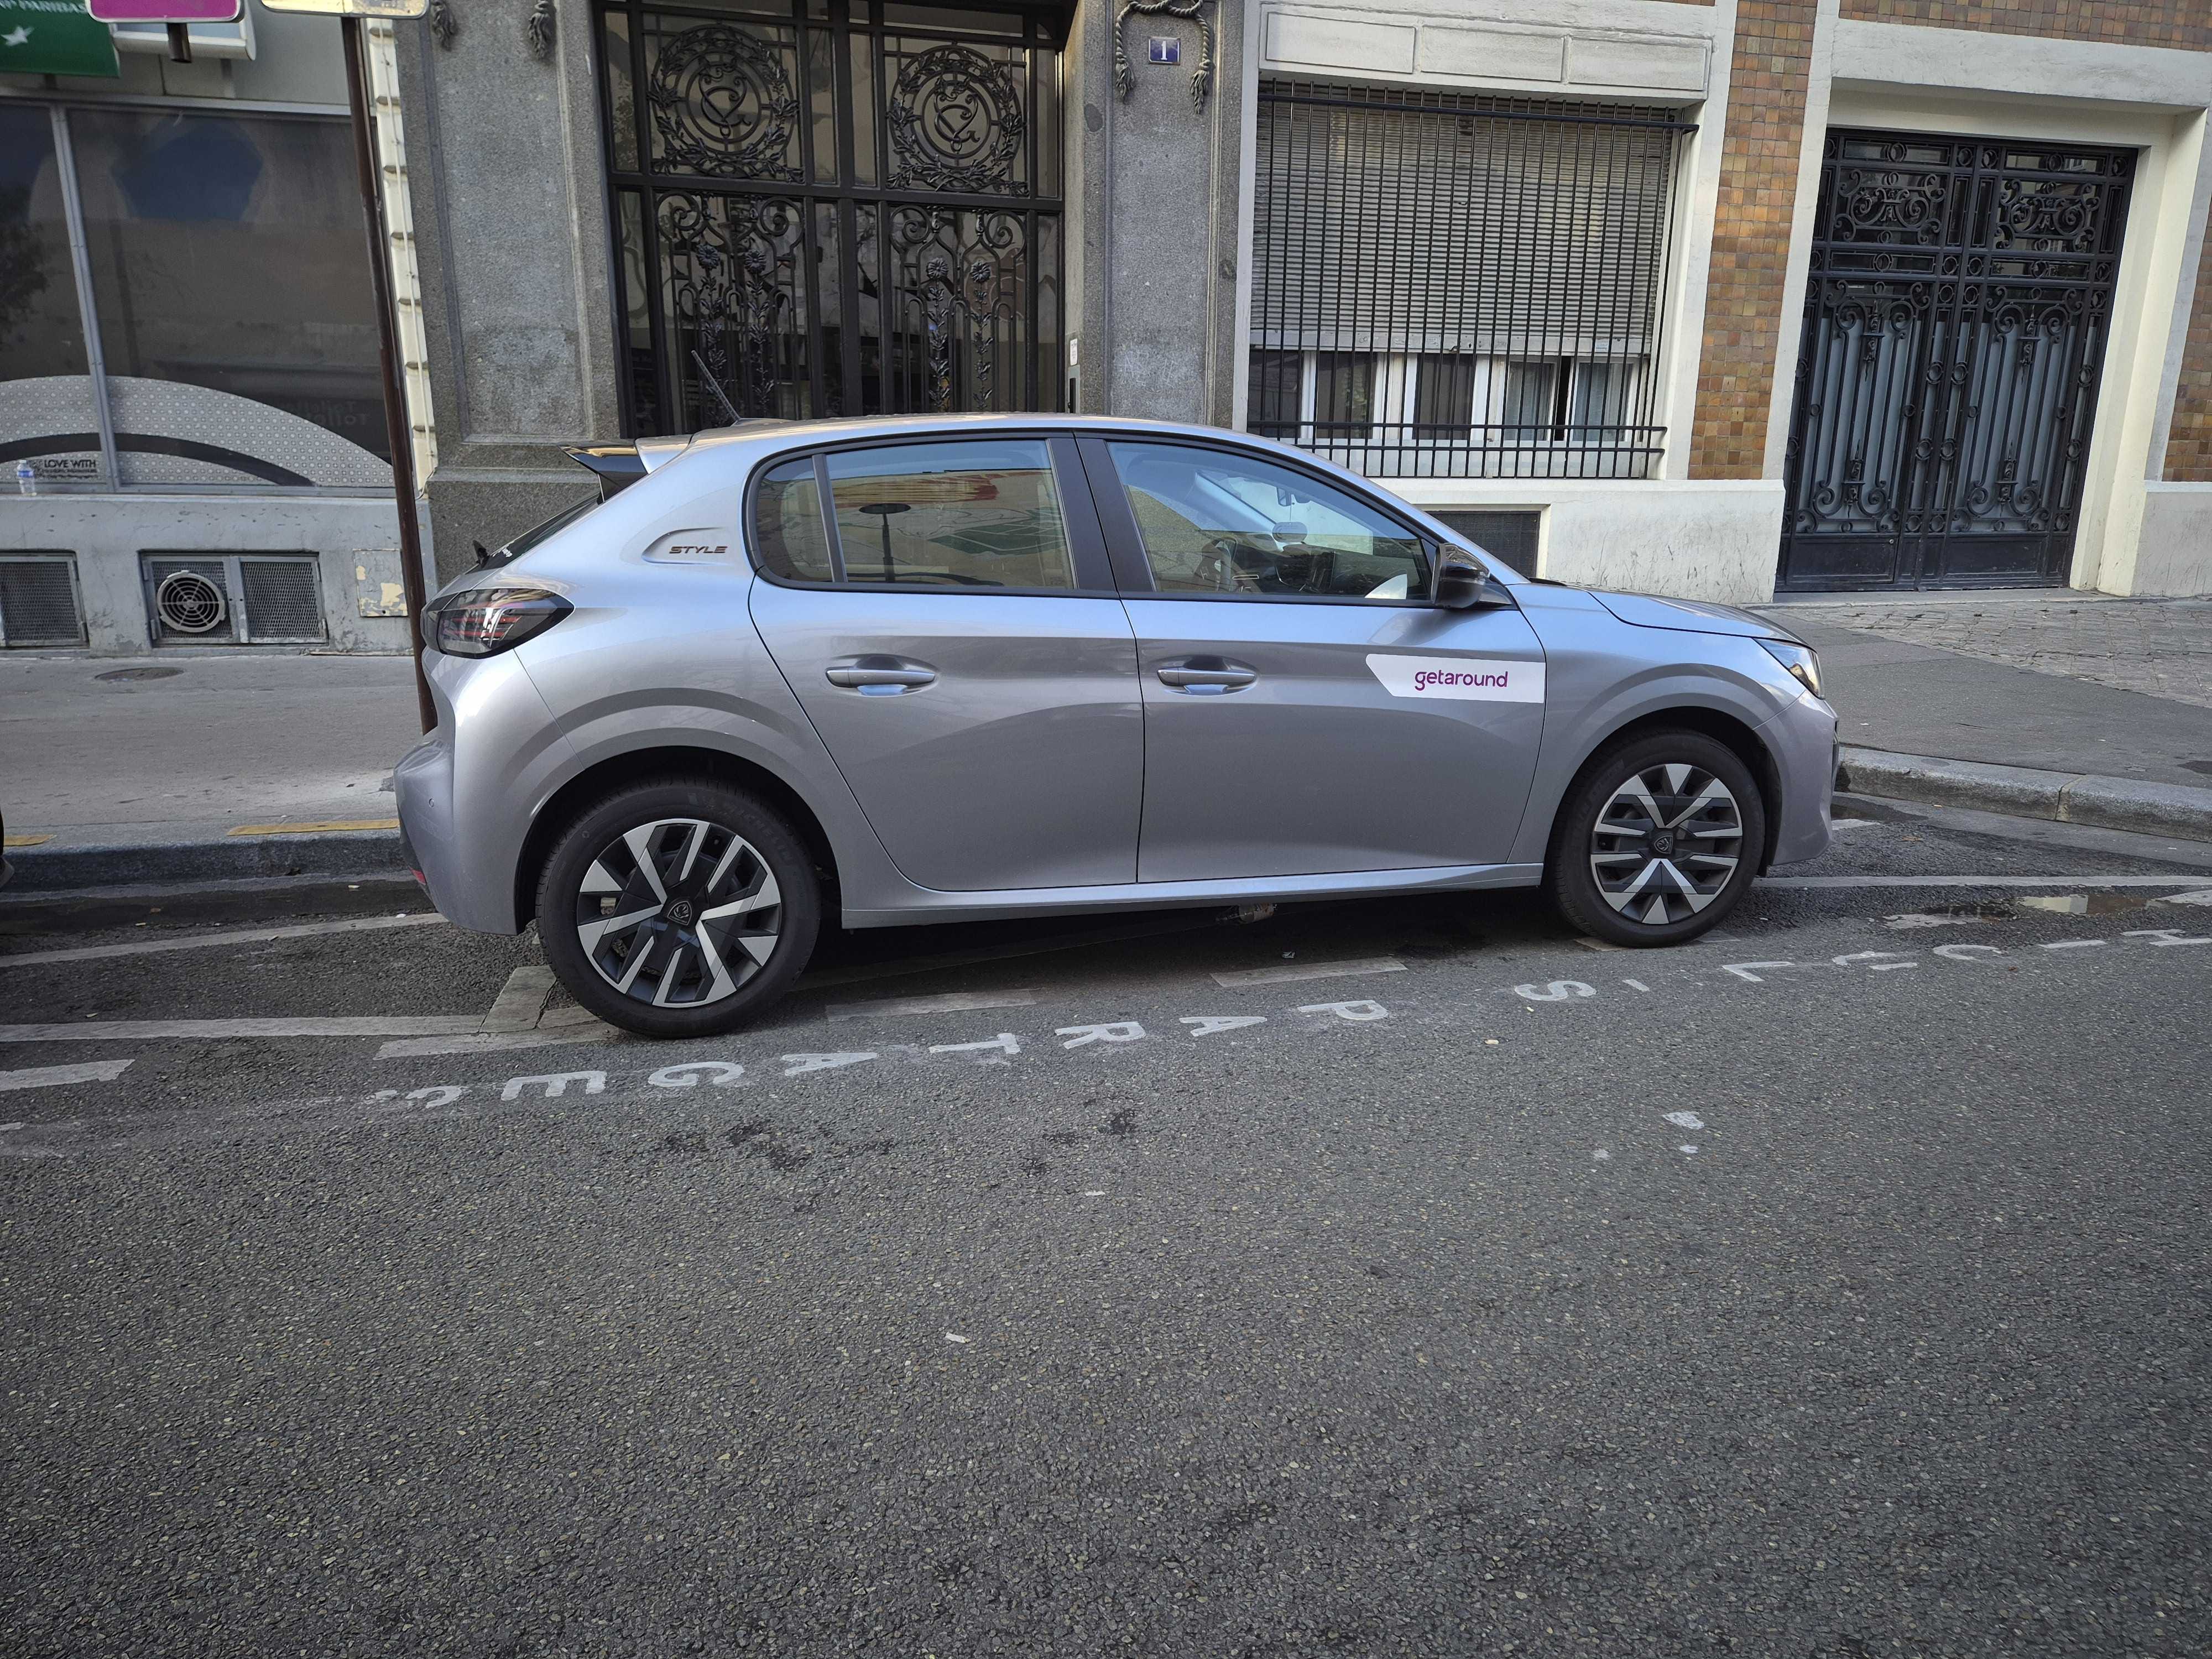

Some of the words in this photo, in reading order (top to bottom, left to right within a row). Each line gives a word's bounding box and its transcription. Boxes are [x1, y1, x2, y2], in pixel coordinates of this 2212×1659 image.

[1160, 40, 1168, 61] 1
[44, 459, 69, 468] LOVE
[70, 459, 96, 468] WITH
[669, 546, 728, 554] STYLE
[1414, 670, 1509, 691] getaround
